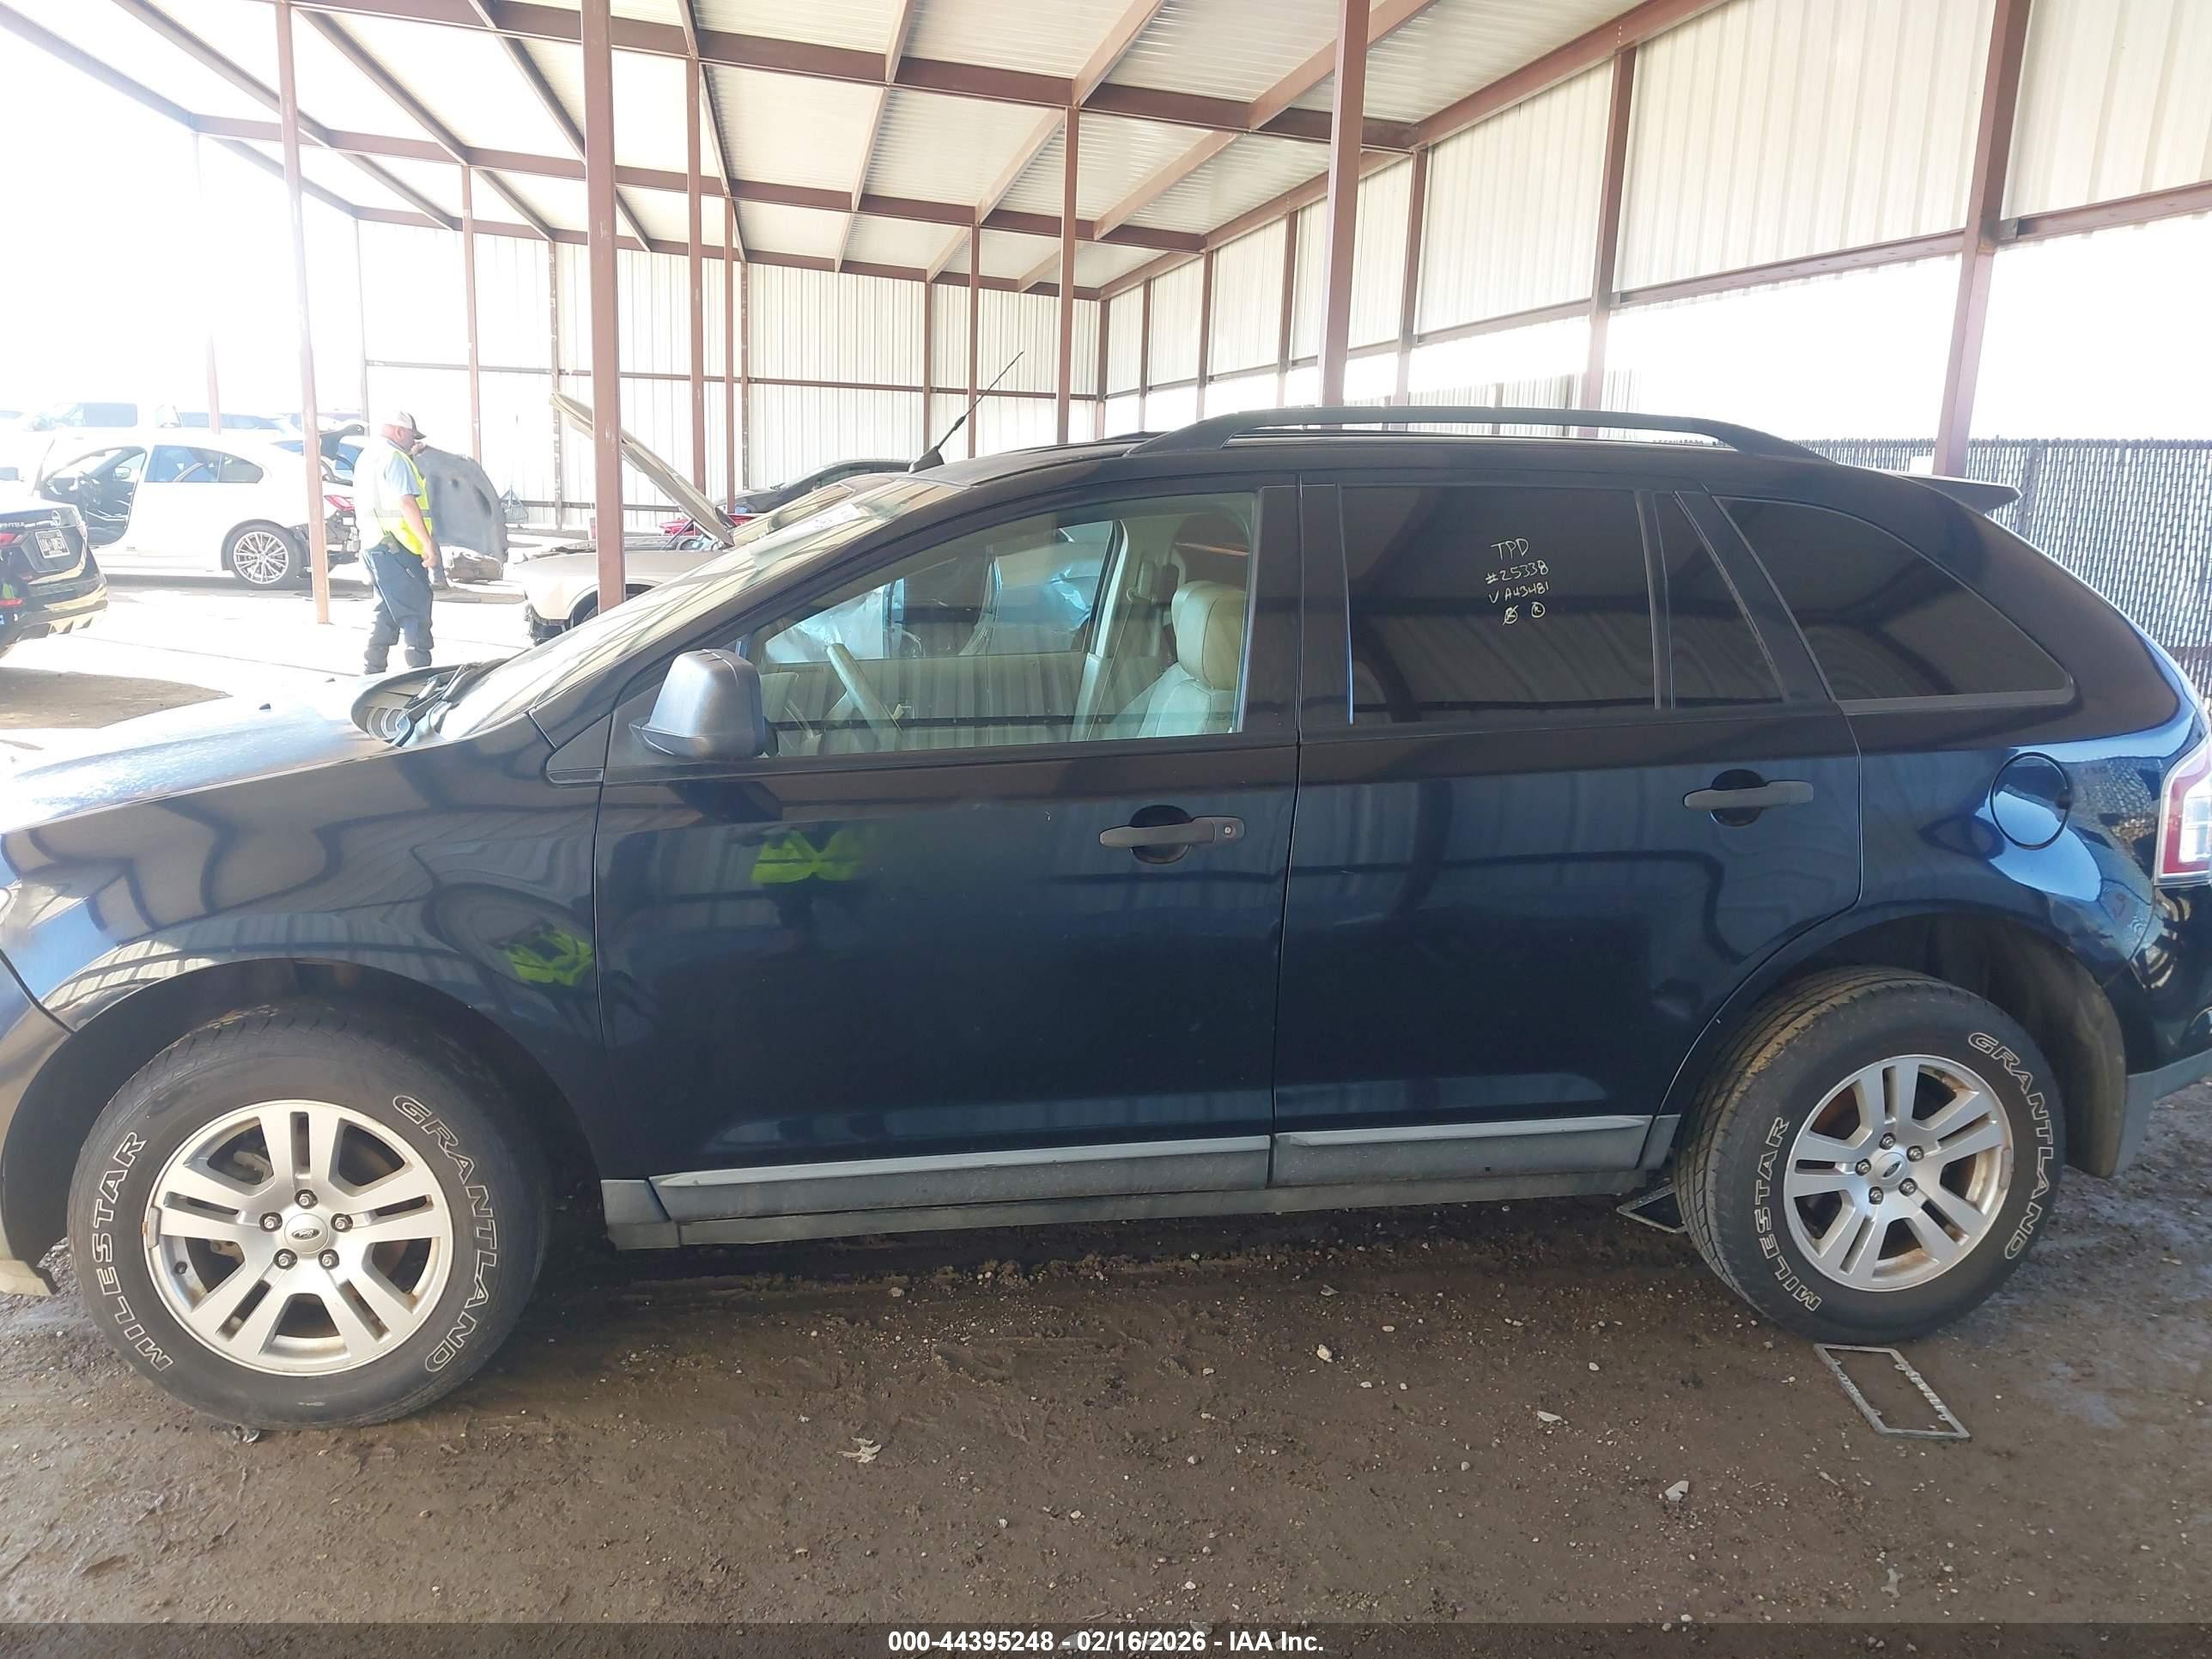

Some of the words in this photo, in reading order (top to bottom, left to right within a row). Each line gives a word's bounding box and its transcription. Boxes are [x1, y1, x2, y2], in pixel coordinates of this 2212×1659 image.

[1485, 559, 1549, 585] #25338
[1491, 538, 1529, 561] TPD
[93, 1131, 173, 1372] MILESTAR
[392, 1095, 500, 1372] GRANTLAND
[1754, 1116, 1822, 1312] MILESTAR
[1968, 1032, 2054, 1260] GRANTLAND
